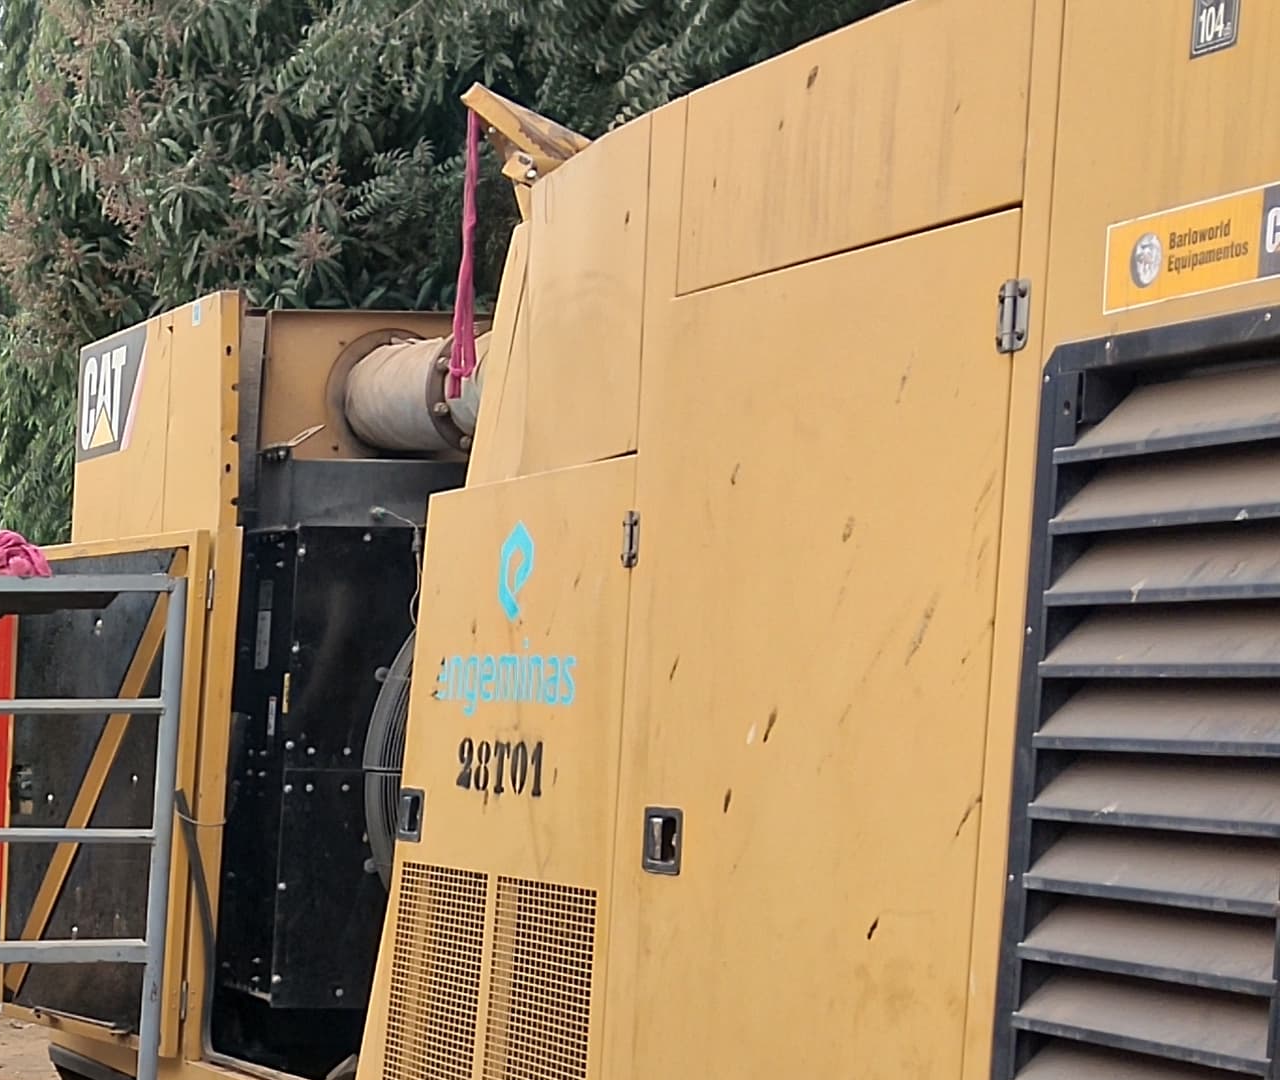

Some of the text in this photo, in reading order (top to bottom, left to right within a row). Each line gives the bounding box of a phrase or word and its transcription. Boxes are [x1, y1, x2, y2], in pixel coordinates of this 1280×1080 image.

[1199, 2, 1225, 44] 104
[1168, 217, 1232, 250] Barloworld
[1167, 240, 1249, 275] Equipamentos
[81, 345, 127, 451] CAT
[455, 736, 545, 798] 28T01
